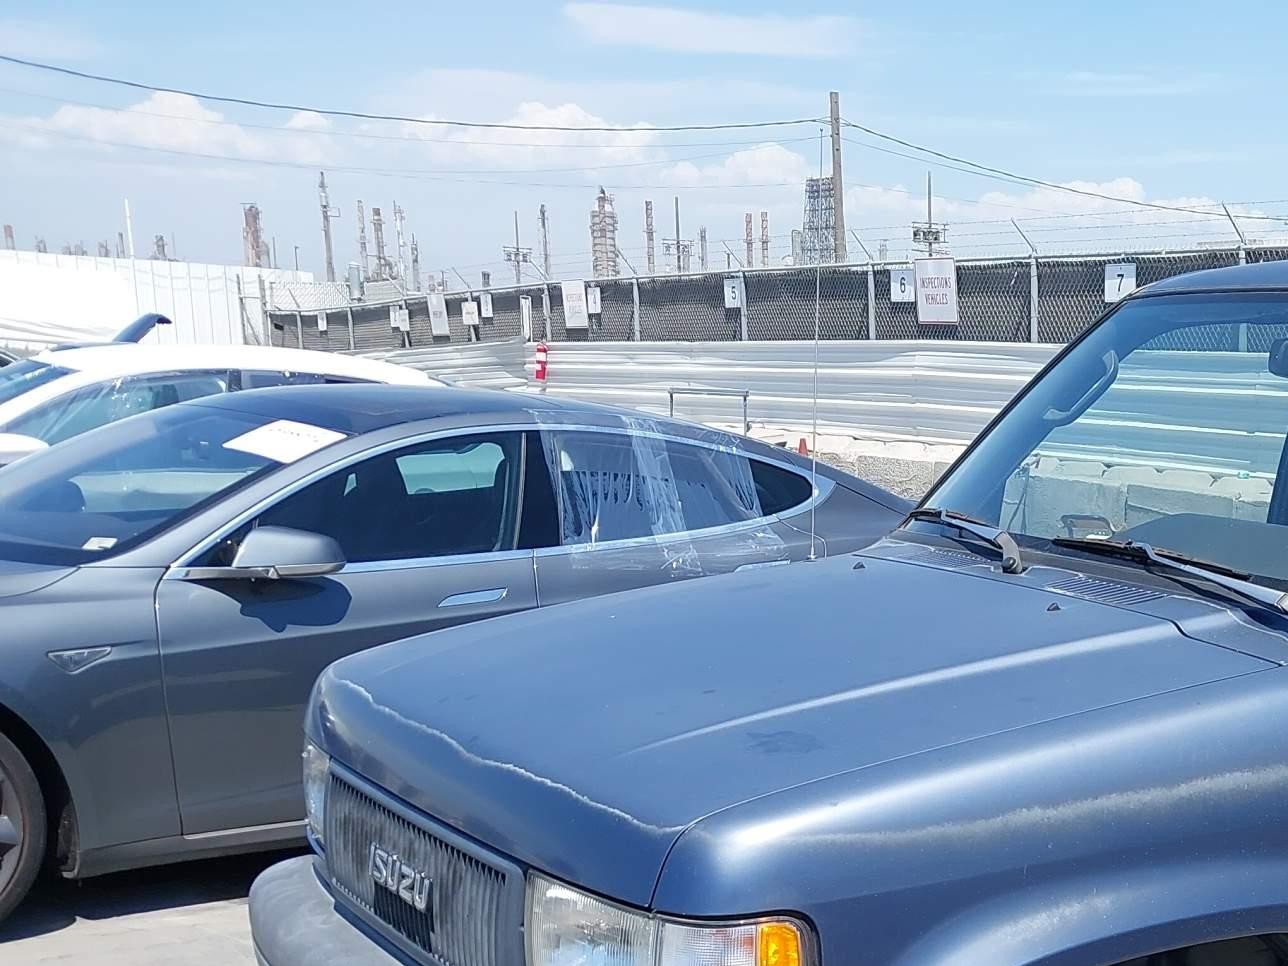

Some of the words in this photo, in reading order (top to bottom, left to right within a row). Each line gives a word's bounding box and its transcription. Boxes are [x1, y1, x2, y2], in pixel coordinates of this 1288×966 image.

[899, 276, 906, 294] 6
[1116, 273, 1125, 292] 7
[731, 285, 737, 300] 5
[925, 293, 948, 305] VEHICLES
[368, 841, 432, 913] ISUZU
